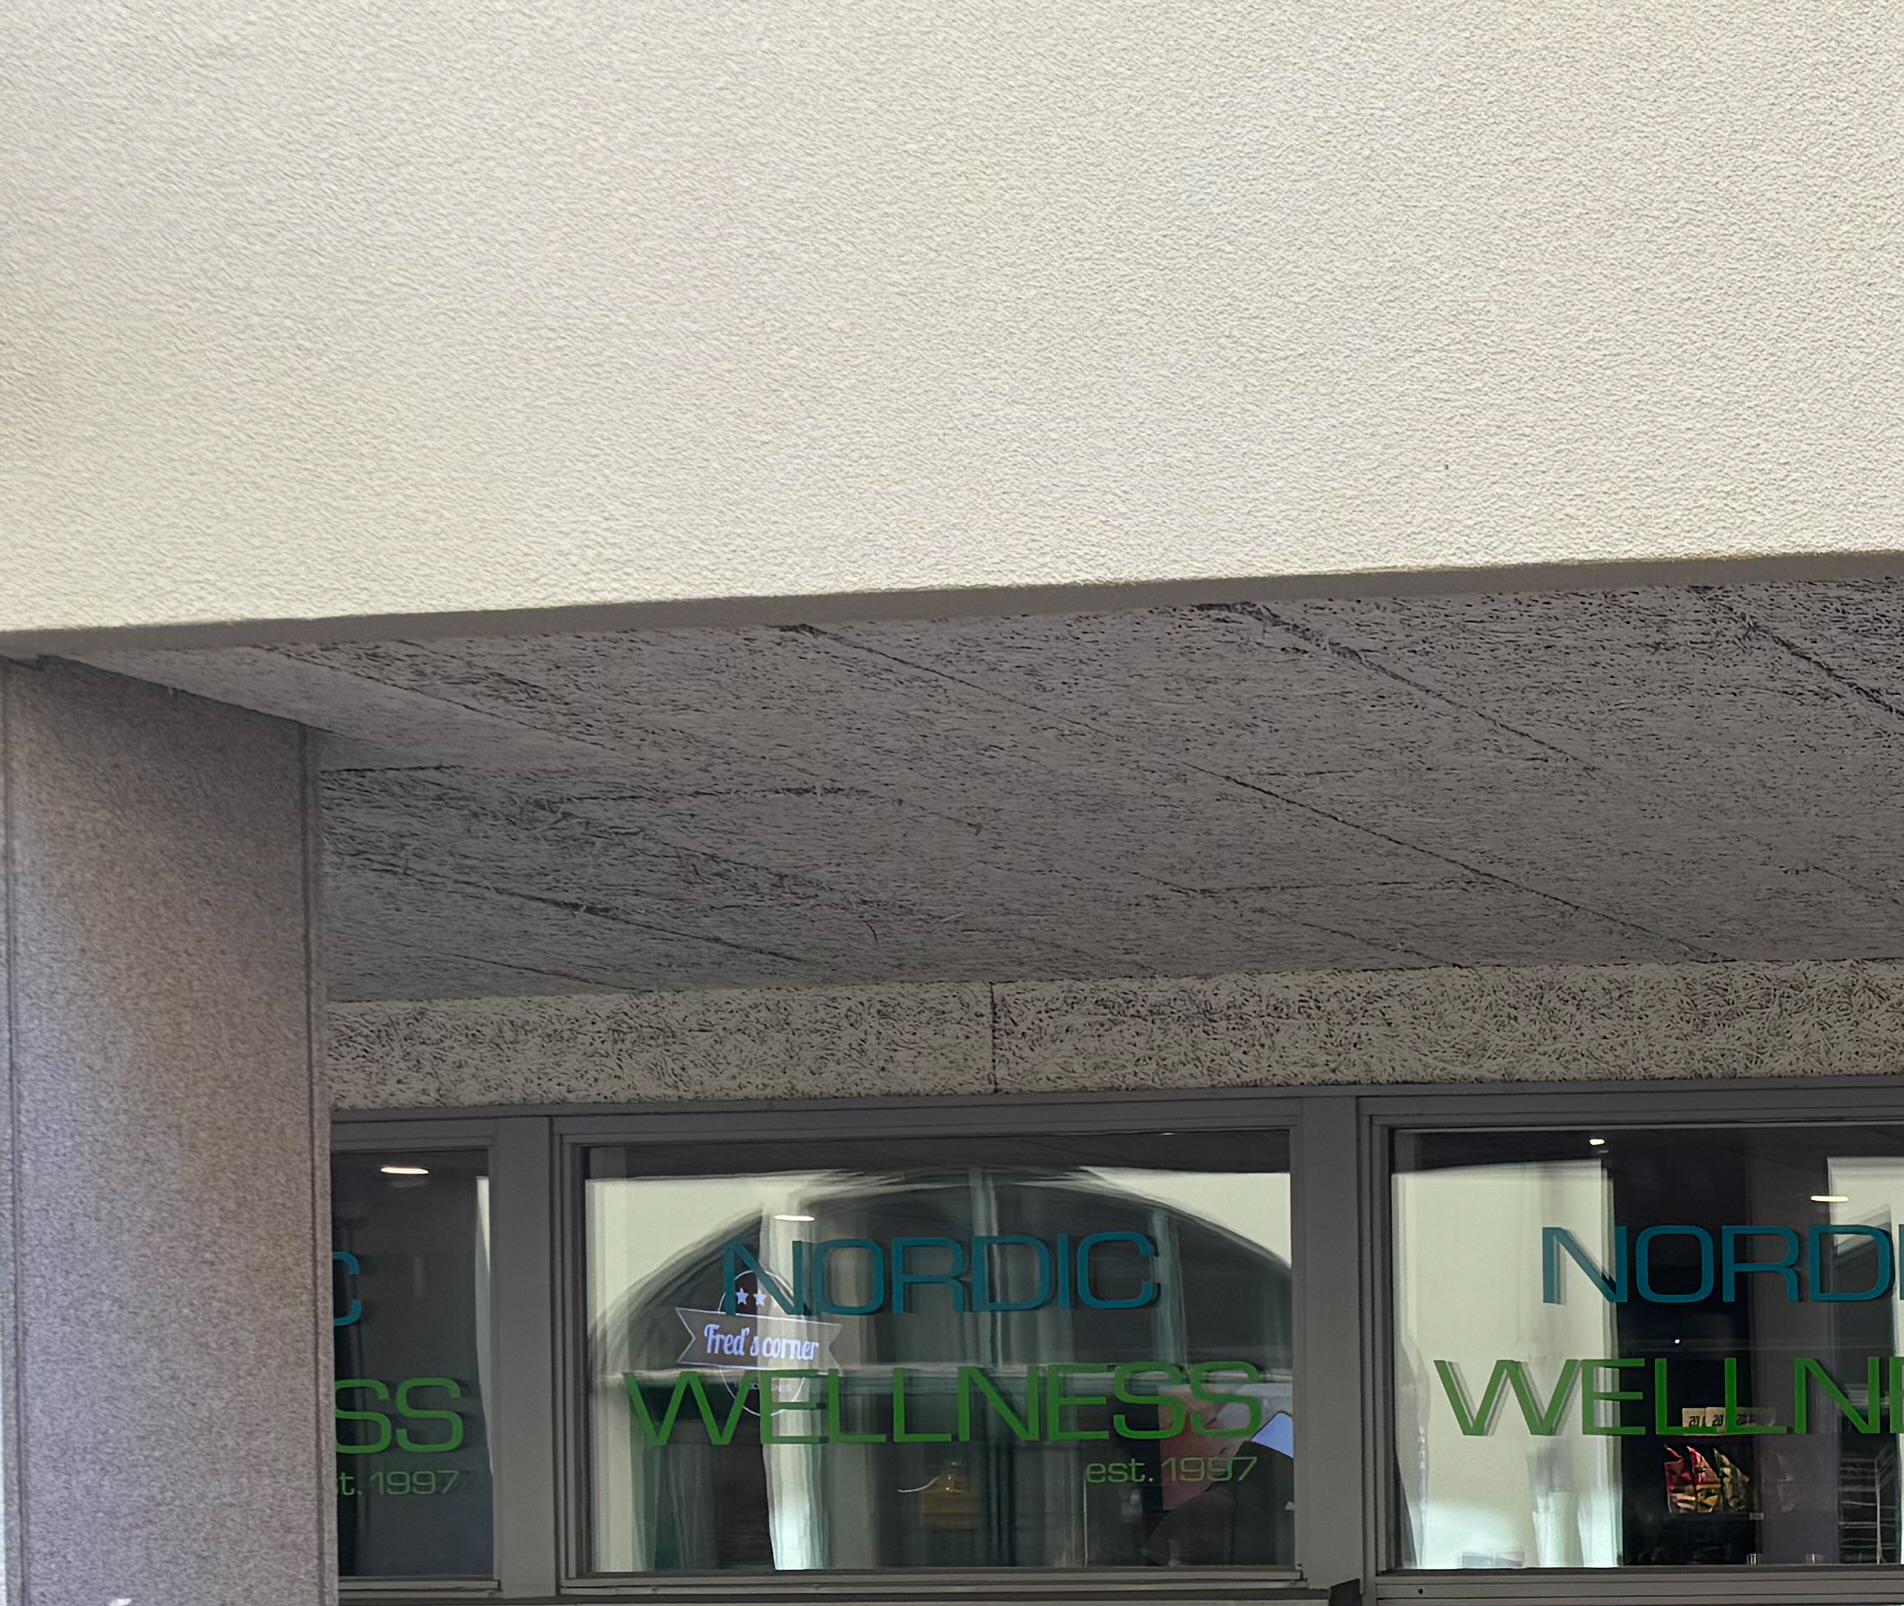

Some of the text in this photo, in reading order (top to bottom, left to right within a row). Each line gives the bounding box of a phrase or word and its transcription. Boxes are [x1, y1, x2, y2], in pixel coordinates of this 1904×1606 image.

[725, 1231, 1159, 1317] NORDIC
[622, 1360, 1264, 1447] WELLNESS
[370, 1470, 460, 1495] 1997
[1085, 1456, 1259, 1484] est. 1997
